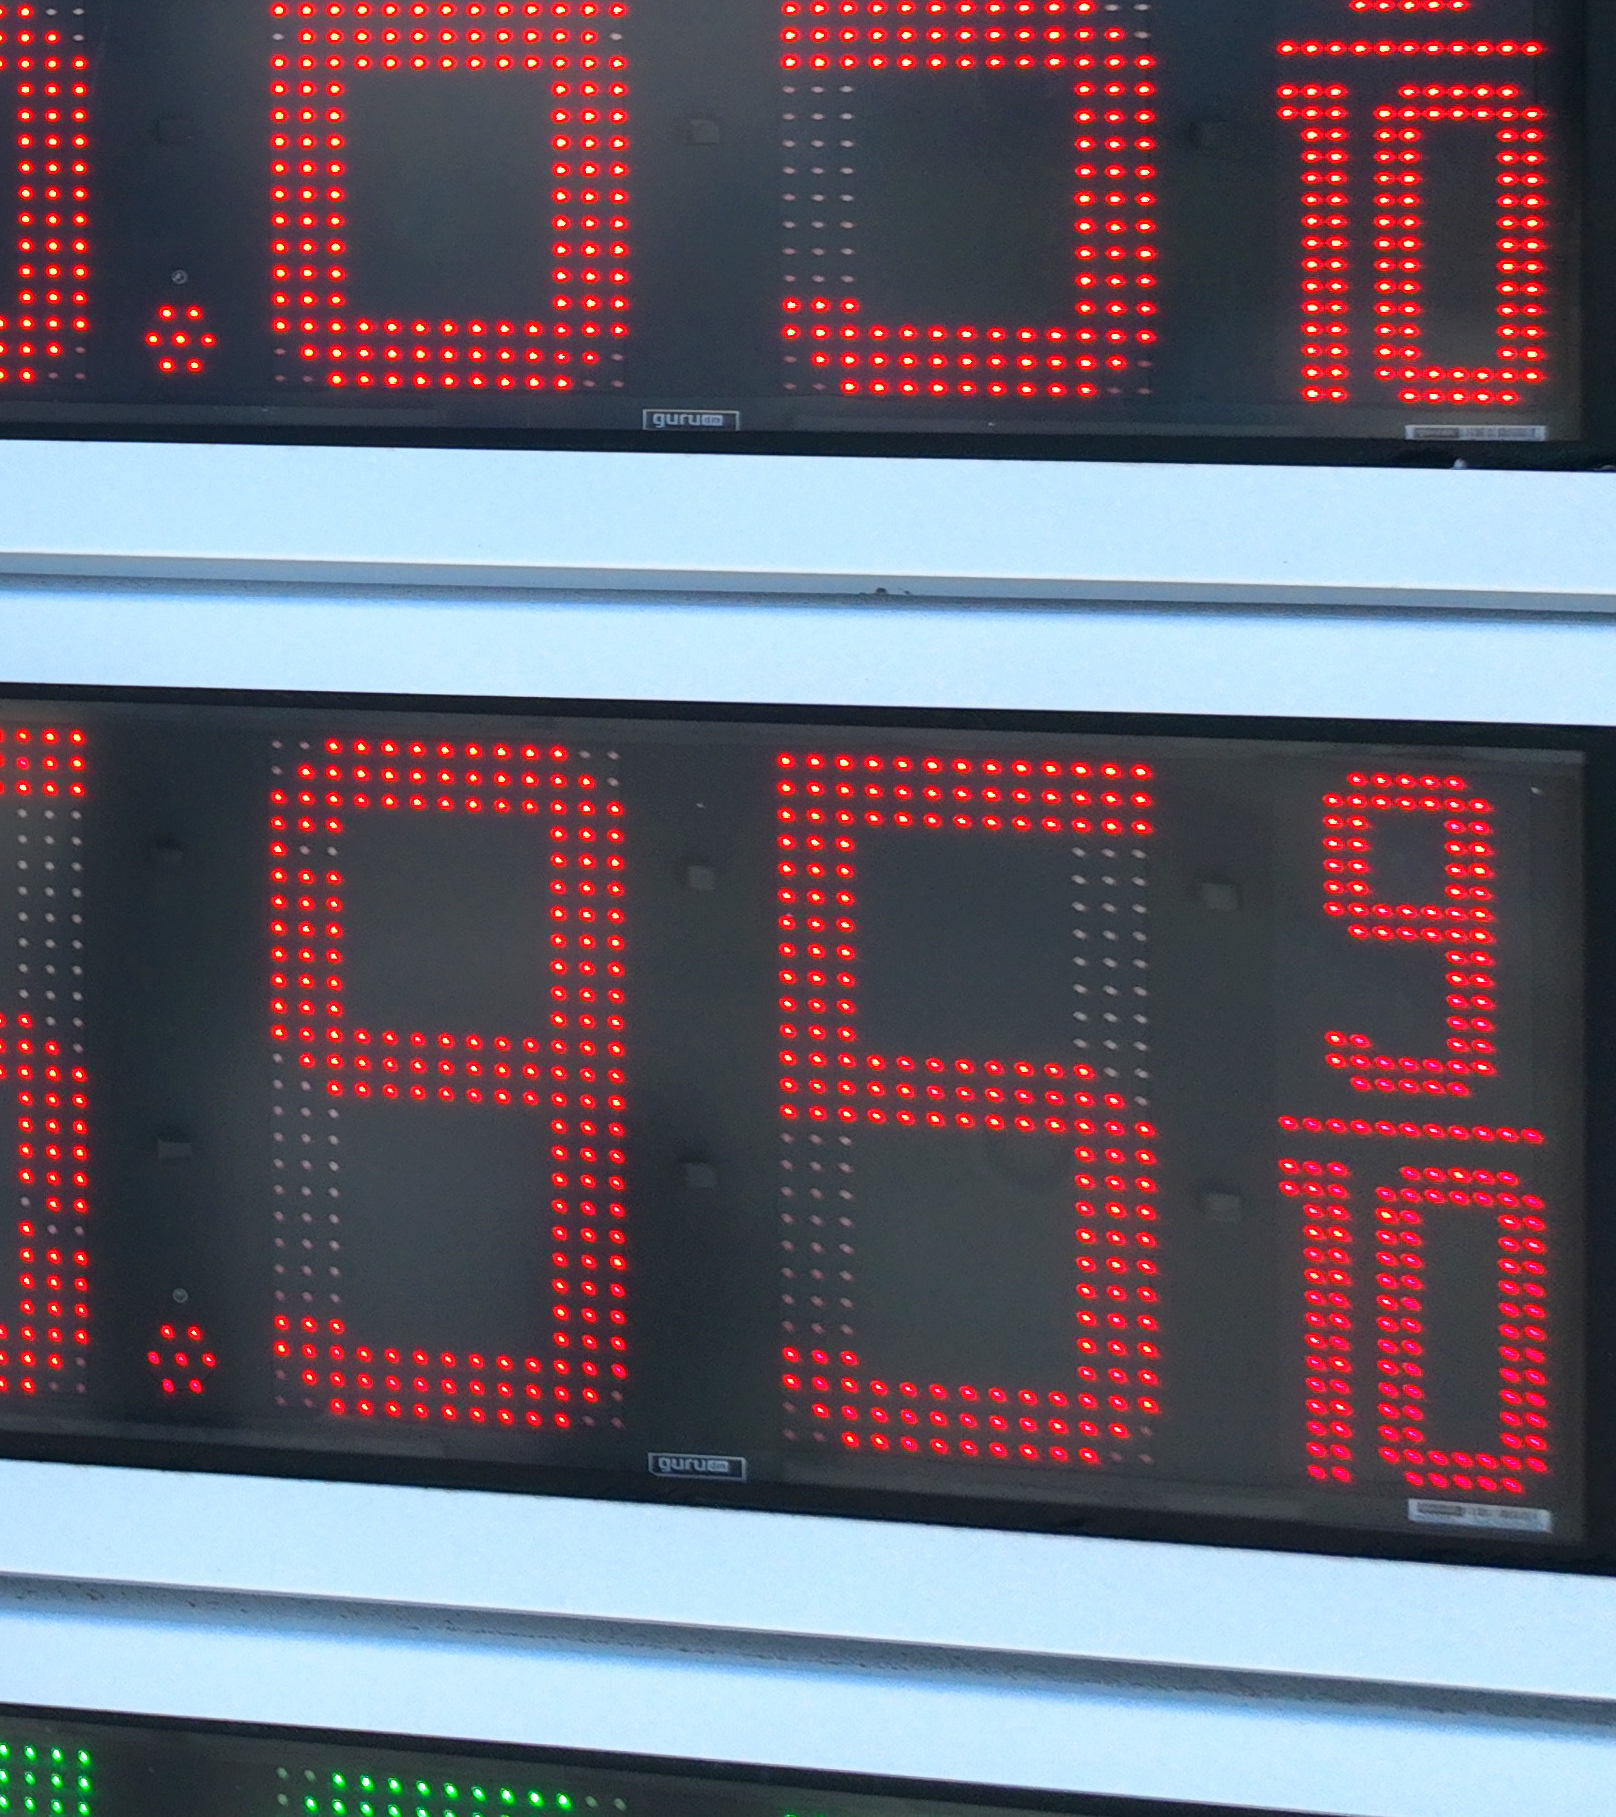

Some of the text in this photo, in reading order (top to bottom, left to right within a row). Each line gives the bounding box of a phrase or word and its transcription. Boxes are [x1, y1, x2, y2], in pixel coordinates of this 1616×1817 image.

[1274, 81, 1553, 408] 10
[1321, 771, 1498, 1101] 9
[1276, 1158, 1550, 1495] 10
